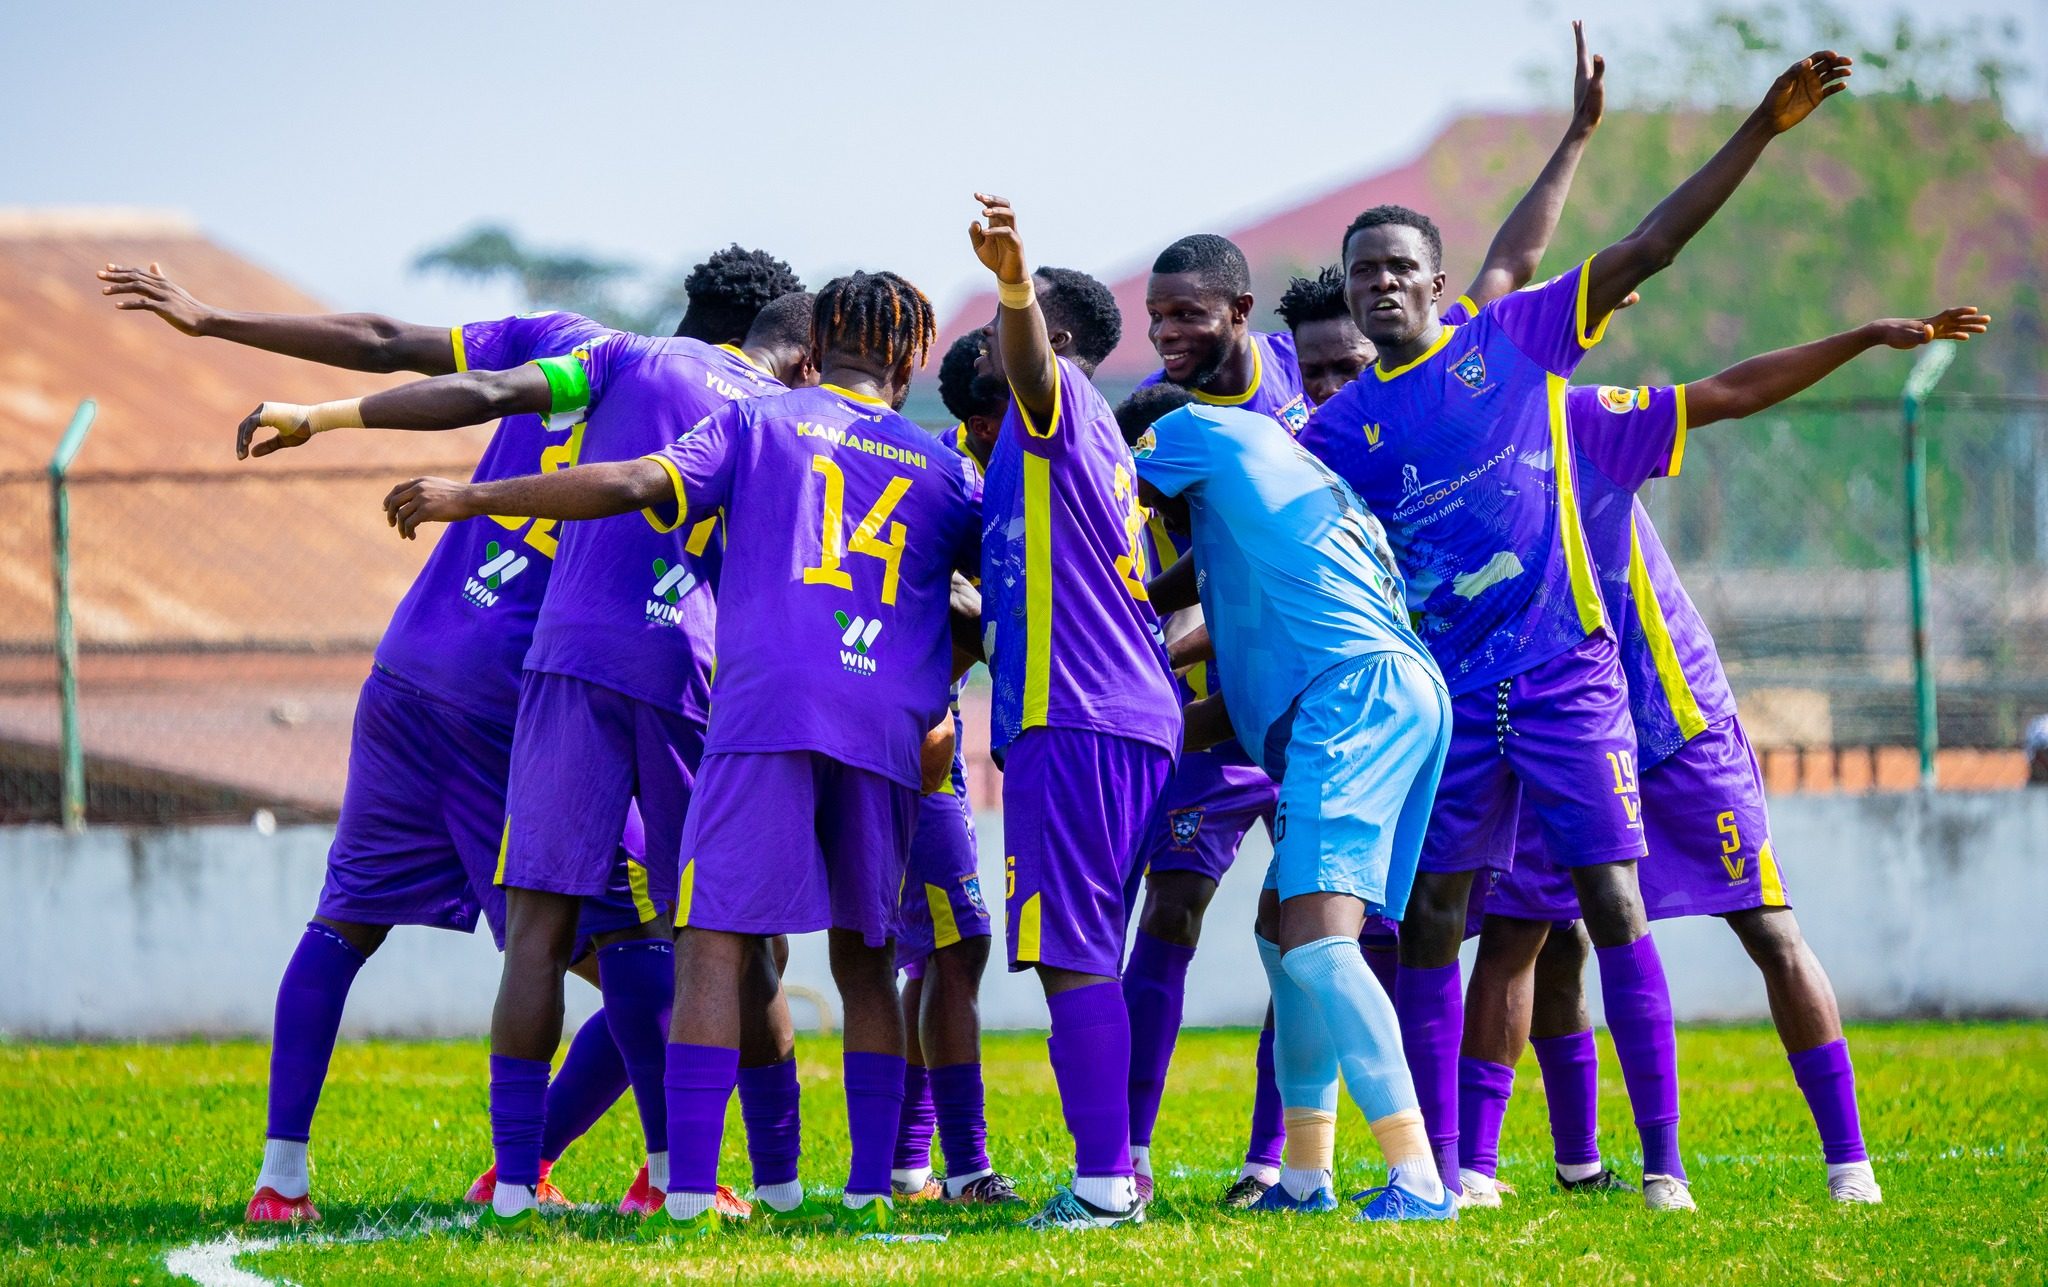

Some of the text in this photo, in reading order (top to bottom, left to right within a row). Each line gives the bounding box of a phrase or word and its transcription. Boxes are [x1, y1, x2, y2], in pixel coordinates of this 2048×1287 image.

[797, 421, 928, 470] KAMARIDINI
[1391, 443, 1516, 522] ANGLOGOLDASHANTI
[1438, 496, 1466, 518] MINE
[803, 454, 914, 607] 14
[464, 576, 499, 608] WIN
[645, 599, 684, 625] WIN
[839, 649, 877, 673] WIN
[1606, 750, 1637, 795] 19
[649, 944, 670, 953] XL
